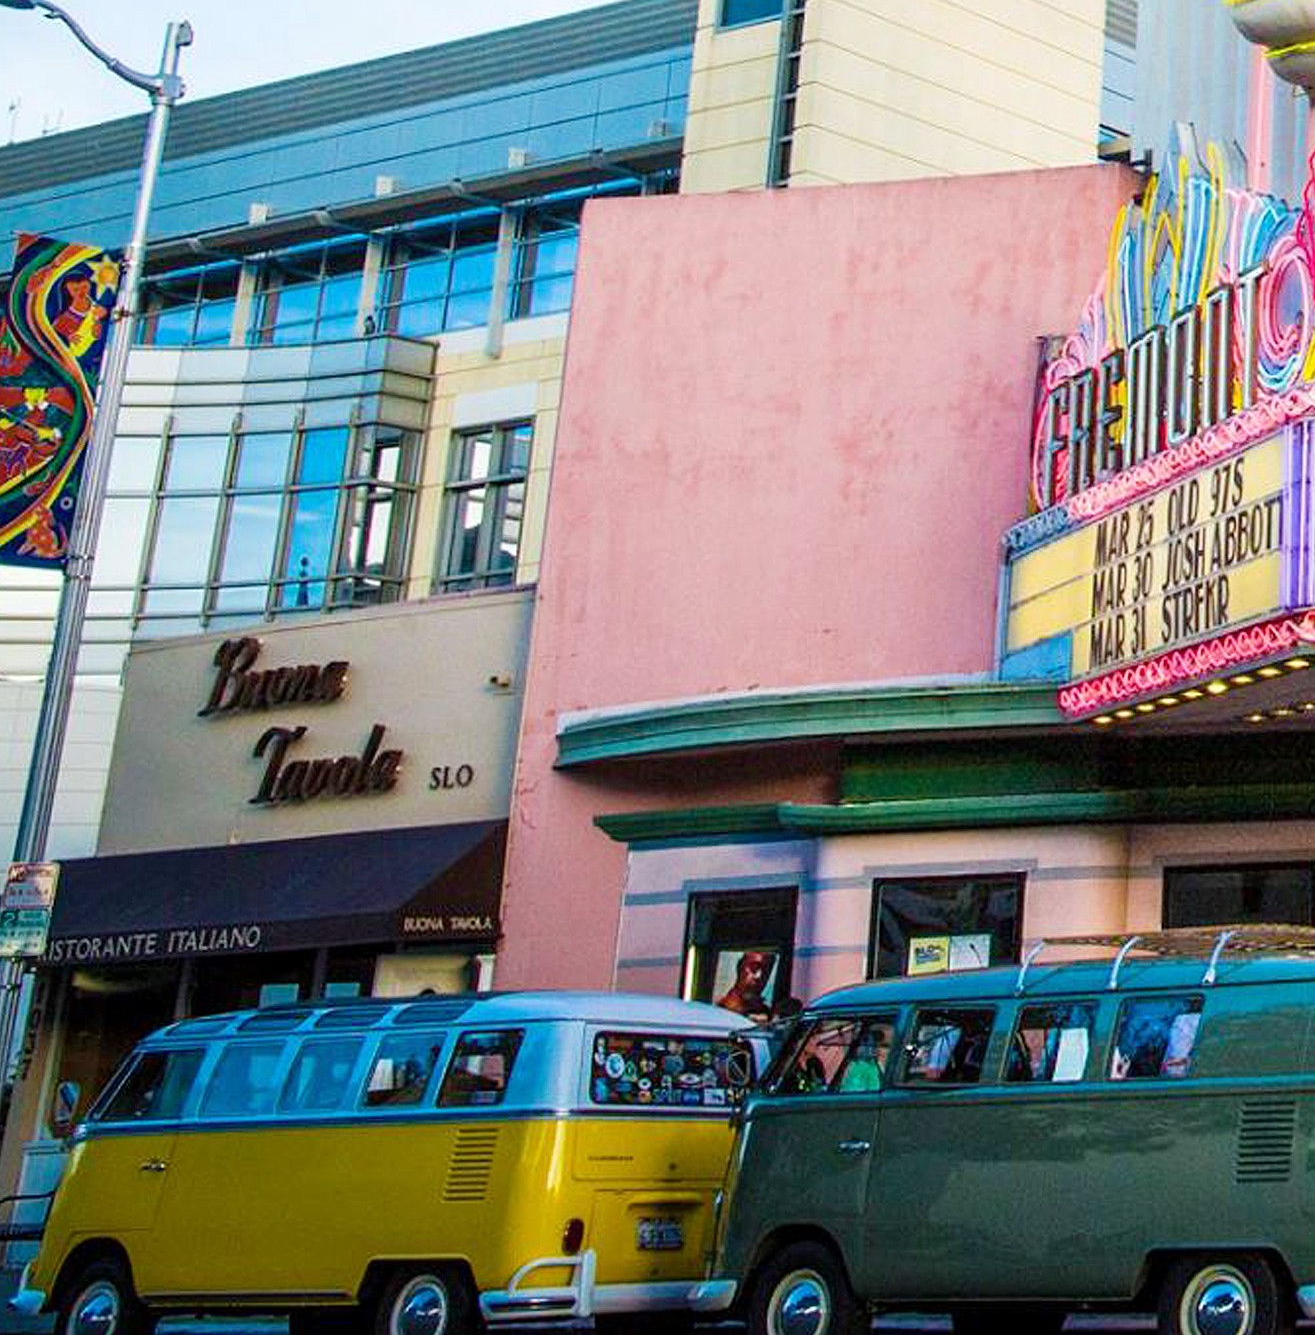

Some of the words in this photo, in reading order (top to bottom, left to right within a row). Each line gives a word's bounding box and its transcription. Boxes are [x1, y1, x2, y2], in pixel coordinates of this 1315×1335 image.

[1042, 261, 1268, 508] FREMONT
[1091, 563, 1127, 618] MAR
[1132, 552, 1152, 602] 30
[1161, 527, 1206, 592] JOSH
[1210, 494, 1284, 572] ABBOTT
[1095, 511, 1130, 567] MAR
[1136, 500, 1155, 552] 25
[1168, 478, 1200, 538] OLD
[1089, 612, 1126, 667] MAR
[1132, 604, 1146, 655] 31
[197, 636, 350, 717] Buona
[248, 723, 403, 804] Tavola
[429, 764, 474, 791] SLO
[168, 925, 261, 954] ITALIANO
[403, 916, 444, 933] BUONA
[450, 915, 492, 931] TAVOLA
